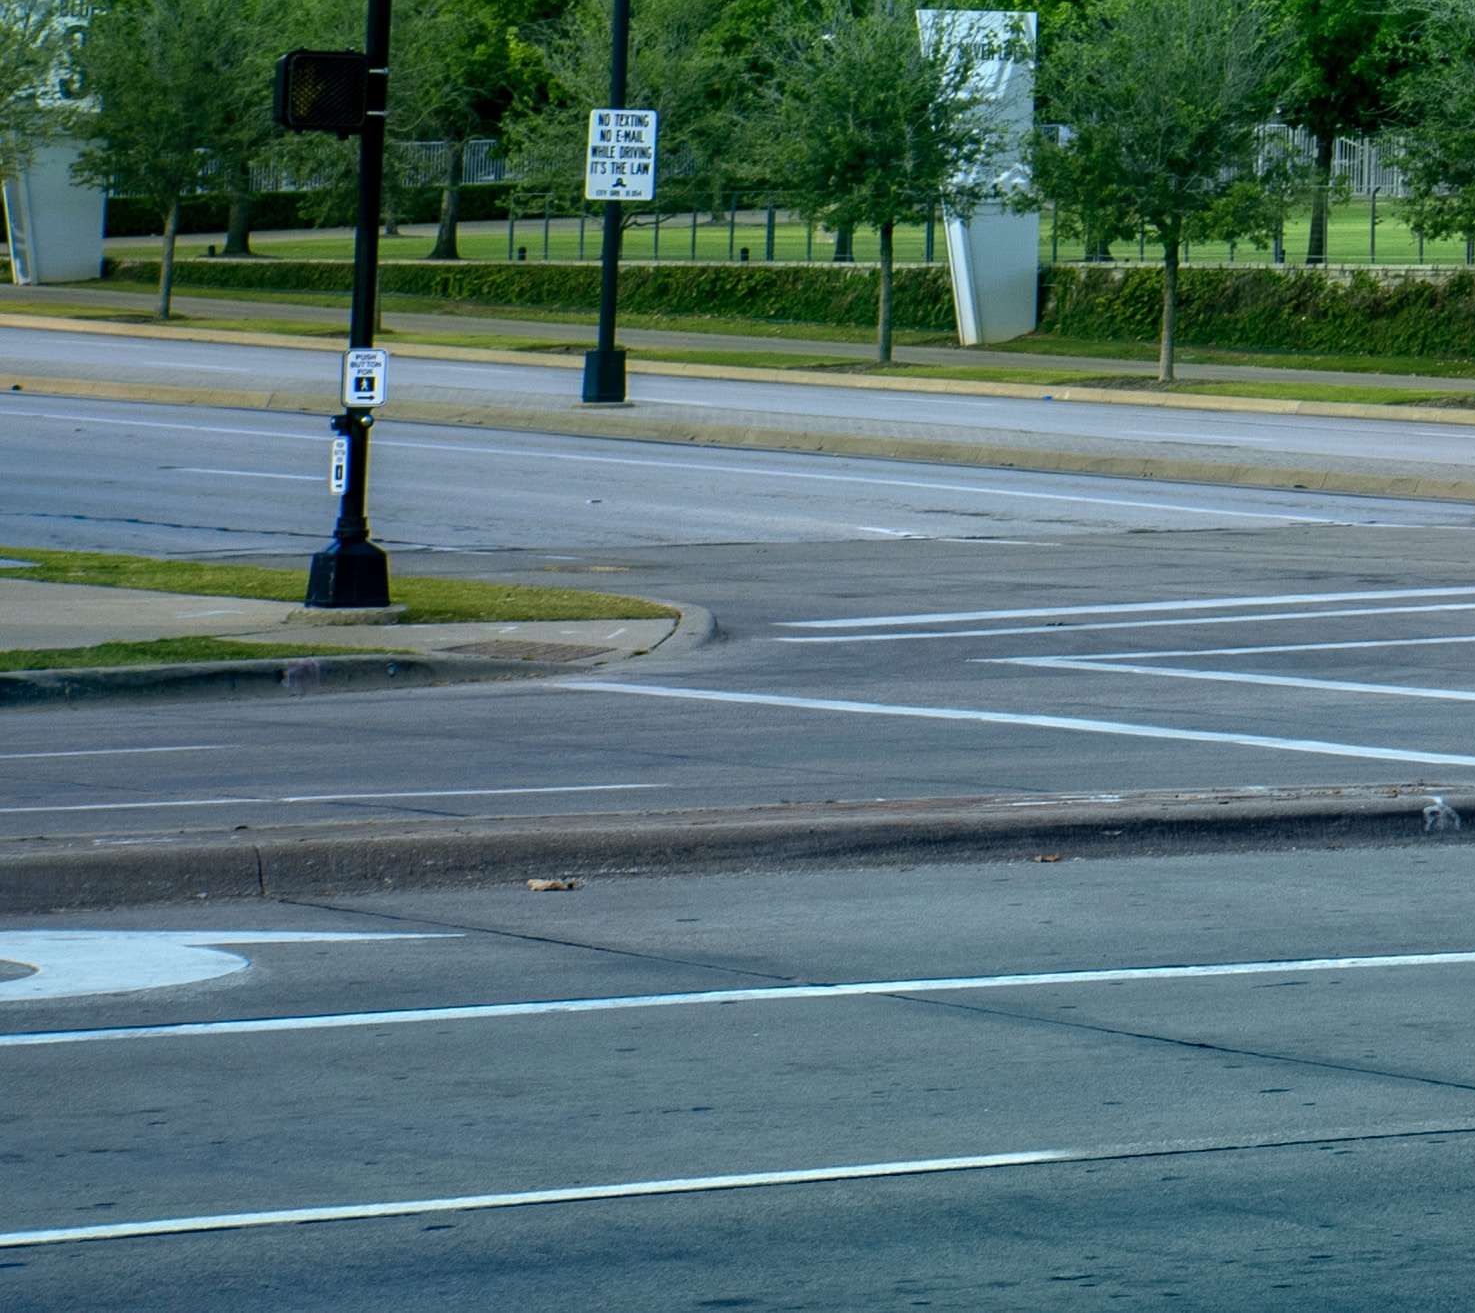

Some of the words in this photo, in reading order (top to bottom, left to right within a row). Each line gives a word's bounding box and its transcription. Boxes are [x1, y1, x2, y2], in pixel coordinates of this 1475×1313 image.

[599, 114, 610, 126] NO
[616, 114, 649, 127] TEXTING
[600, 130, 612, 142] NO
[616, 130, 644, 142] E-MAIL
[592, 146, 616, 158] WHILE
[620, 146, 652, 159] DRIVING
[591, 161, 606, 174] IT'S
[612, 162, 626, 174] THE
[631, 162, 650, 174] LAW
